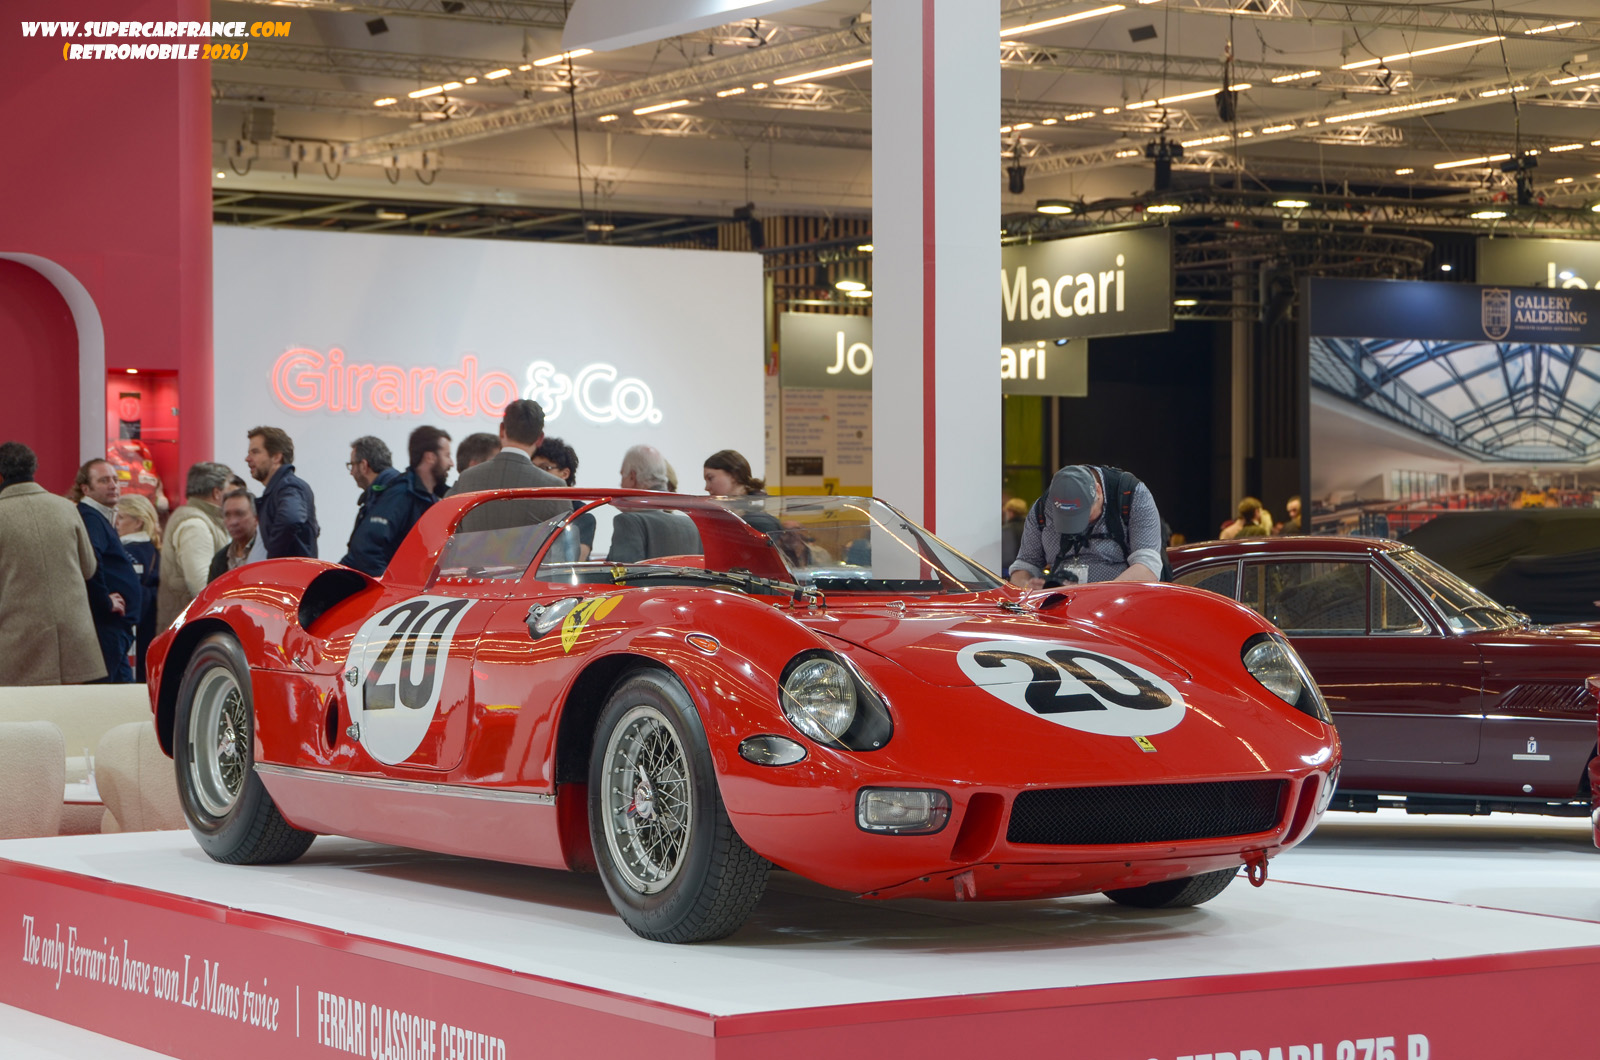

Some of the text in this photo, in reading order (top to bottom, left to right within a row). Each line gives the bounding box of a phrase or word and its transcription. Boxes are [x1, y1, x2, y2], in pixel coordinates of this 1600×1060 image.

[1001, 253, 1125, 322] Macari
[1514, 295, 1573, 310] GALLERY
[1514, 310, 1588, 325] AALDERING
[271, 347, 519, 418] Girardo
[363, 599, 470, 711] 20
[973, 649, 1172, 714] 20
[22, 914, 280, 1032] The only Ferrari to have won Le Mans twice
[318, 990, 367, 1057] FERRARI
[370, 1004, 437, 1060] CLASSICHE
